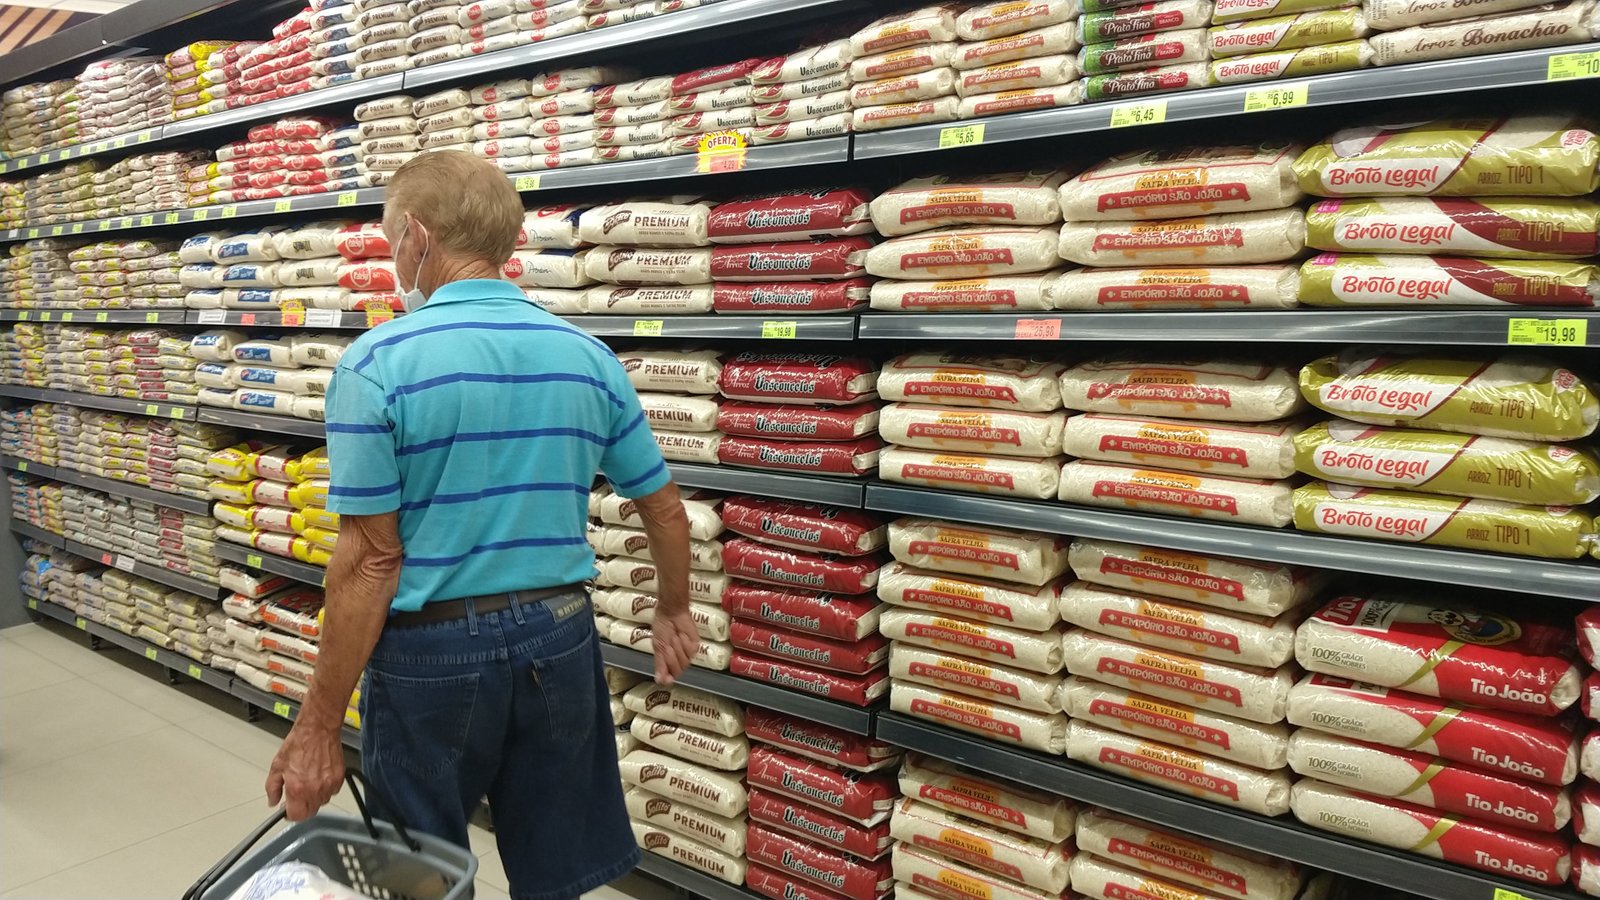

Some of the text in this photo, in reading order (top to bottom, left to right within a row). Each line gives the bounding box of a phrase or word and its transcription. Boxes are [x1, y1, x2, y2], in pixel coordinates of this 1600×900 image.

[1397, 2, 1446, 15] Arroz
[1159, 16, 1179, 24] BRANCO
[1405, 20, 1571, 54] Arroz Bonachão
[1220, 59, 1280, 77] Broto Legal
[1163, 77, 1184, 85] BRANCO
[707, 135, 738, 149] OFERTA
[1329, 166, 1437, 188] Broto Legal
[1507, 166, 1533, 183] TIPO
[1539, 166, 1543, 183] 1
[634, 216, 689, 227] PREMIUM
[1345, 223, 1455, 245] Broto Legal
[1525, 223, 1551, 242] TIPO
[1558, 223, 1564, 242] 1
[637, 255, 692, 266] PREMIUM
[638, 290, 692, 300] PREMIUM
[1342, 276, 1452, 300] Broto Legal
[1523, 276, 1549, 295] TIPO
[1555, 276, 1560, 295] 1
[1544, 327, 1575, 344] 19,98
[645, 364, 699, 376] PREMIUM
[1327, 385, 1432, 411] Broto Legal
[1500, 399, 1524, 419] TIPO
[1531, 403, 1535, 419] 1
[1322, 451, 1429, 479] Broto Legal
[1497, 468, 1521, 488] TIPO
[1527, 472, 1532, 489] 1
[1322, 508, 1427, 536] Broto Legal
[1494, 525, 1520, 544] TIPO
[1525, 529, 1530, 545] 1
[1143, 555, 1199, 572] SAFRA VELHA
[762, 563, 825, 585] Vasconcelos
[770, 634, 830, 662] Vasconcelos
[1312, 647, 1341, 662] 100%
[1141, 658, 1197, 678] SAFRA VELHA
[770, 667, 830, 695] Vasconcelos
[1471, 678, 1546, 705] Tio João
[673, 700, 720, 720] PREMIUM
[1131, 700, 1187, 720] SAFRA VELHA
[1312, 712, 1341, 727] 100%
[1309, 757, 1338, 772] 100%
[1471, 747, 1544, 778] Tio João
[669, 776, 719, 803] PREMIUM
[782, 773, 844, 806] Vasconcelos
[1466, 793, 1539, 824] Tio João
[674, 813, 726, 842] PREMIUM
[784, 809, 845, 842] Vasconcelos
[1319, 812, 1348, 826] 100%
[944, 836, 989, 856] SAFRA VELHA
[673, 847, 725, 874] PREMIUM
[782, 851, 845, 887] Vasconcelos
[1475, 851, 1548, 881] Tio João
